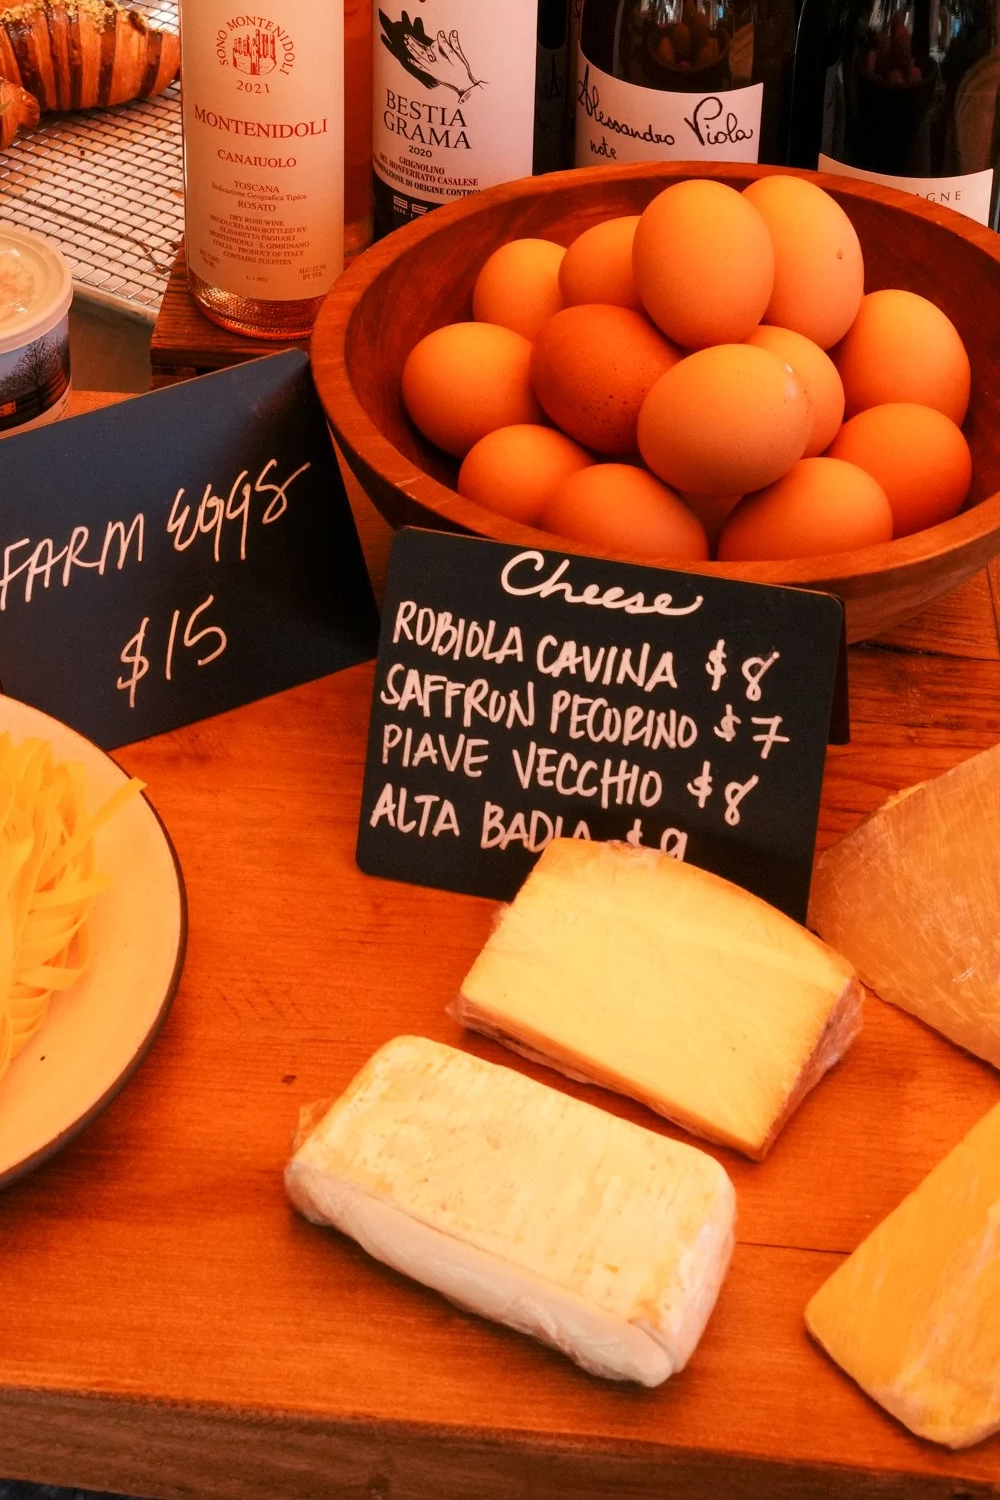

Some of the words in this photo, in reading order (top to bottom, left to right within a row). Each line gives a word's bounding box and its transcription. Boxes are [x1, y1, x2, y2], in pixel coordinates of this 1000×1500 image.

[216, 29, 229, 66] SONO
[226, 15, 296, 75] MONTENIDOLI
[236, 79, 271, 94] 2021
[386, 88, 468, 128] BESTIA
[576, 64, 675, 146] Alessandro
[684, 96, 754, 147] Viola
[194, 104, 328, 139] MONTENIDOLI
[383, 110, 472, 150] GRAMA
[217, 149, 297, 168] CANAIUOLO
[408, 145, 433, 158] 2020
[590, 137, 617, 160] note
[398, 155, 445, 175] GRIGNOLINO
[234, 180, 280, 194] TOSCANA
[413, 180, 445, 195] ORIGINE
[437, 173, 479, 187] CASALESE
[238, 199, 276, 212] ROSATO
[247, 191, 284, 202] Geografica
[286, 193, 307, 202] Tipica
[209, 214, 244, 229] PRODUCED
[244, 224, 260, 232] AND
[261, 225, 295, 234] BOTTLED
[229, 213, 242, 222] DRY
[244, 216, 263, 225] ROSE
[264, 219, 284, 227] WINE
[238, 247, 271, 257] PRODUCT
[283, 249, 305, 258] ITALY
[266, 241, 310, 250] GIMIGNANO
[166, 458, 311, 563] EGGS
[500, 550, 704, 616] Cheese
[116, 594, 227, 708] $15
[392, 600, 523, 664] ROBIOLA
[536, 634, 678, 692] CAVINA
[380, 663, 535, 729] SAFFRON
[550, 689, 698, 750] PECORINO
[382, 723, 490, 778] PIAVE
[512, 741, 663, 809] VECCHIO
[370, 782, 460, 837] ALTA
